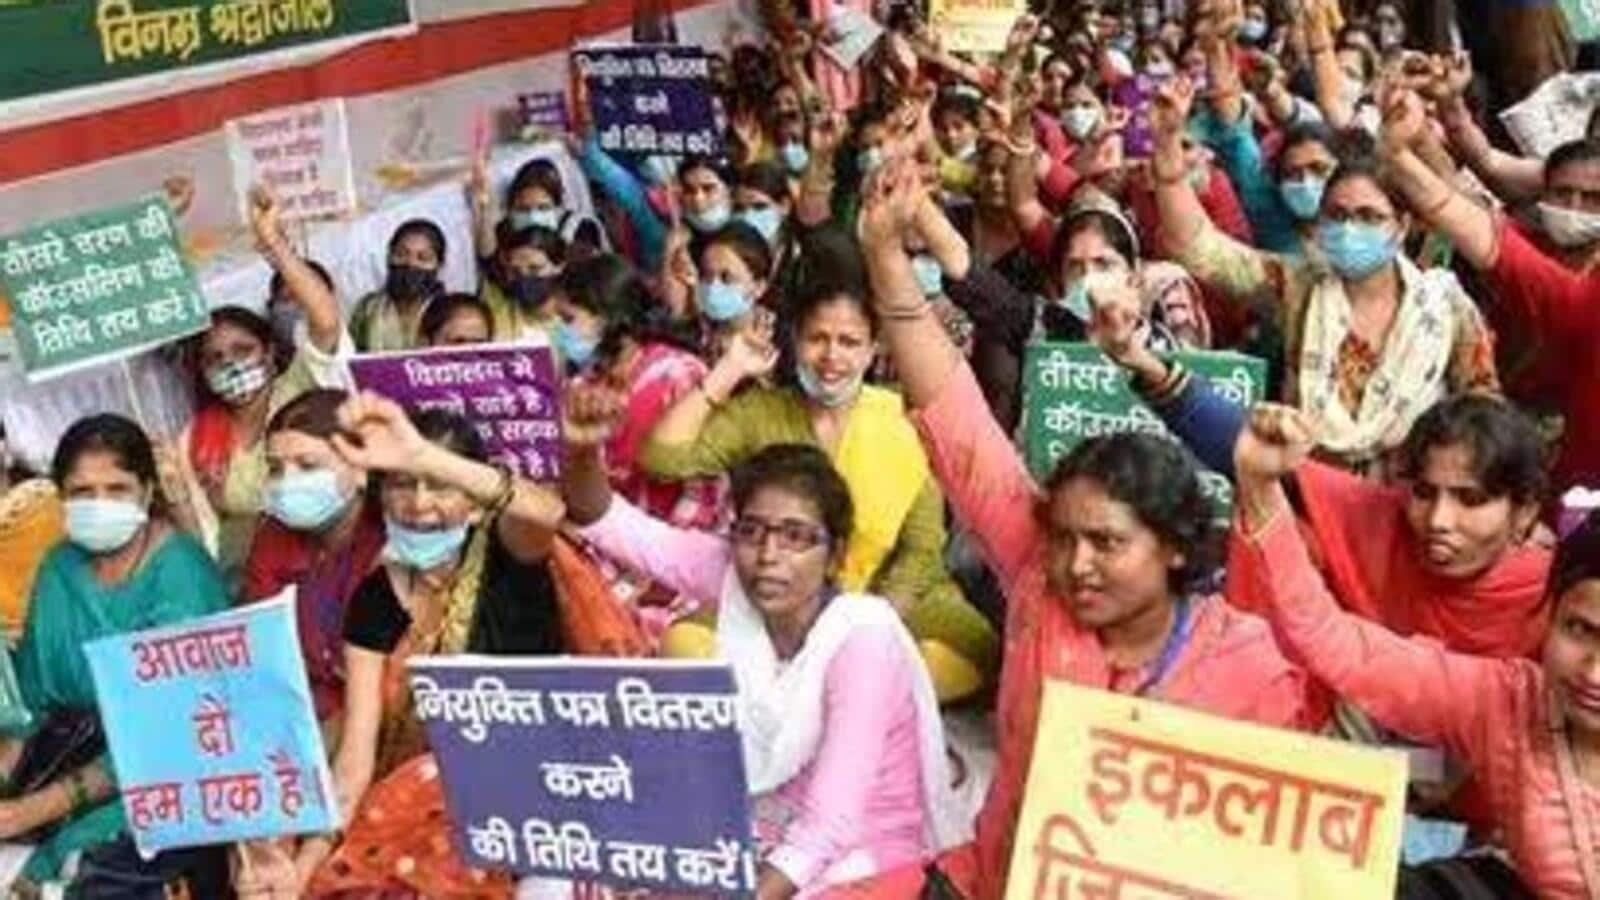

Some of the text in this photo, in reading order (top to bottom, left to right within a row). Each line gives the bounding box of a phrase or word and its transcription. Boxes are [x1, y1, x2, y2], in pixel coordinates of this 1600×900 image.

[97, 0, 201, 64] विनम्र
[1038, 349, 1120, 395] तीसरे
[131, 623, 251, 684] आवाज
[411, 675, 745, 742] नियुक्ति पत्र वितरण
[124, 779, 184, 829] हम
[196, 771, 263, 826] एक
[540, 754, 634, 804] करने
[467, 815, 518, 866] की
[521, 818, 600, 873] तिथि
[606, 839, 668, 883] तय
